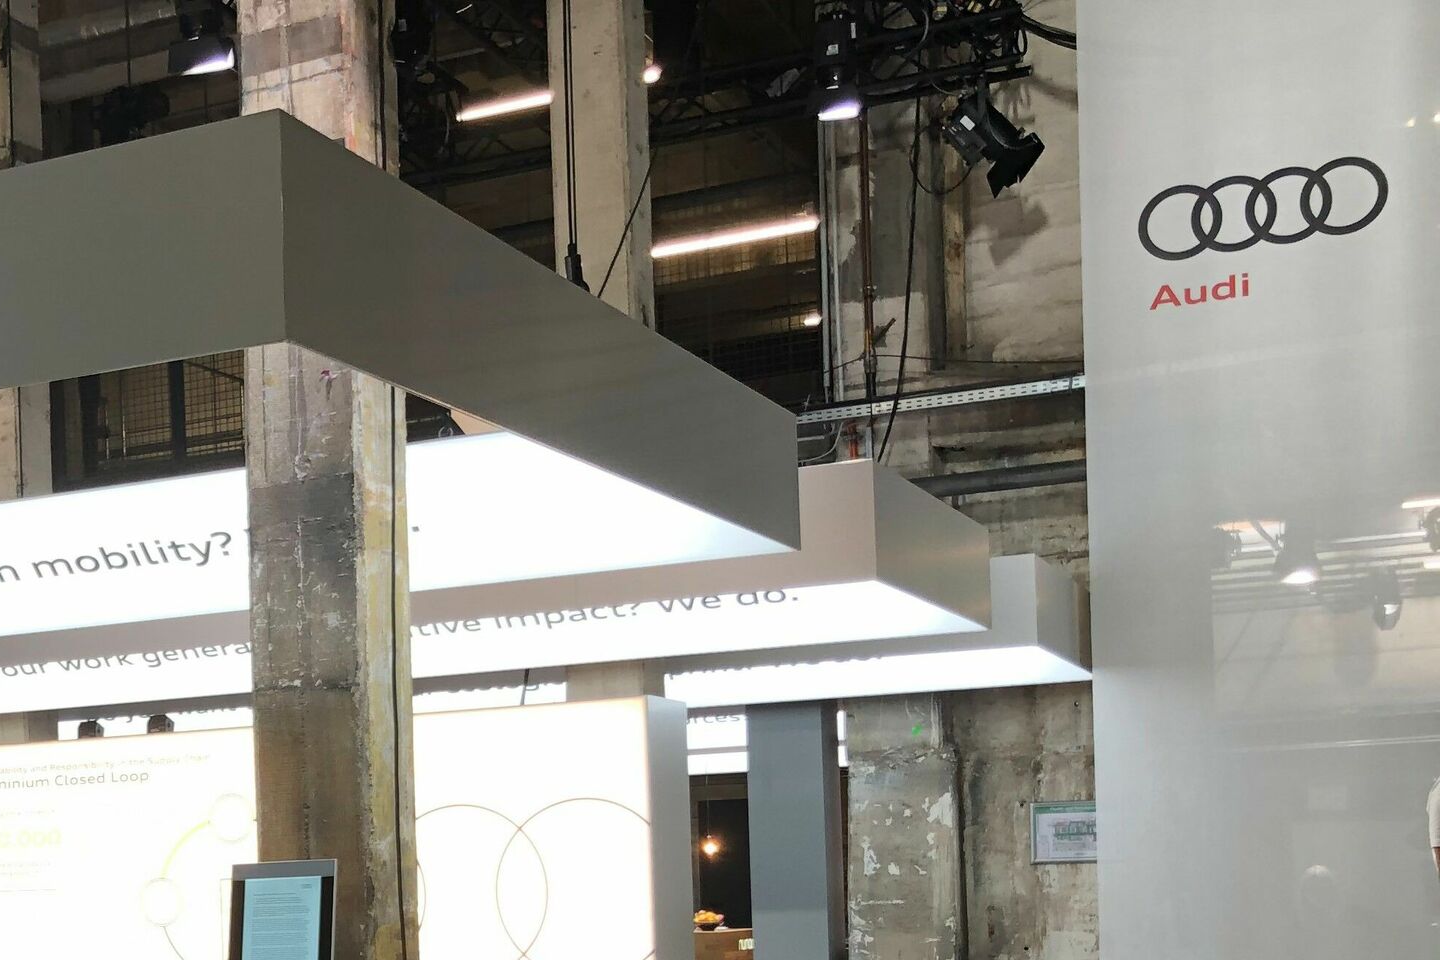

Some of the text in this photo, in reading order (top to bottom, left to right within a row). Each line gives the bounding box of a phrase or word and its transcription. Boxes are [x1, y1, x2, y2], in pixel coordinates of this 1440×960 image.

[1150, 272, 1249, 310] Audi
[31, 532, 232, 578] mobility?
[54, 772, 105, 787] Closed
[111, 771, 150, 784] Loop
